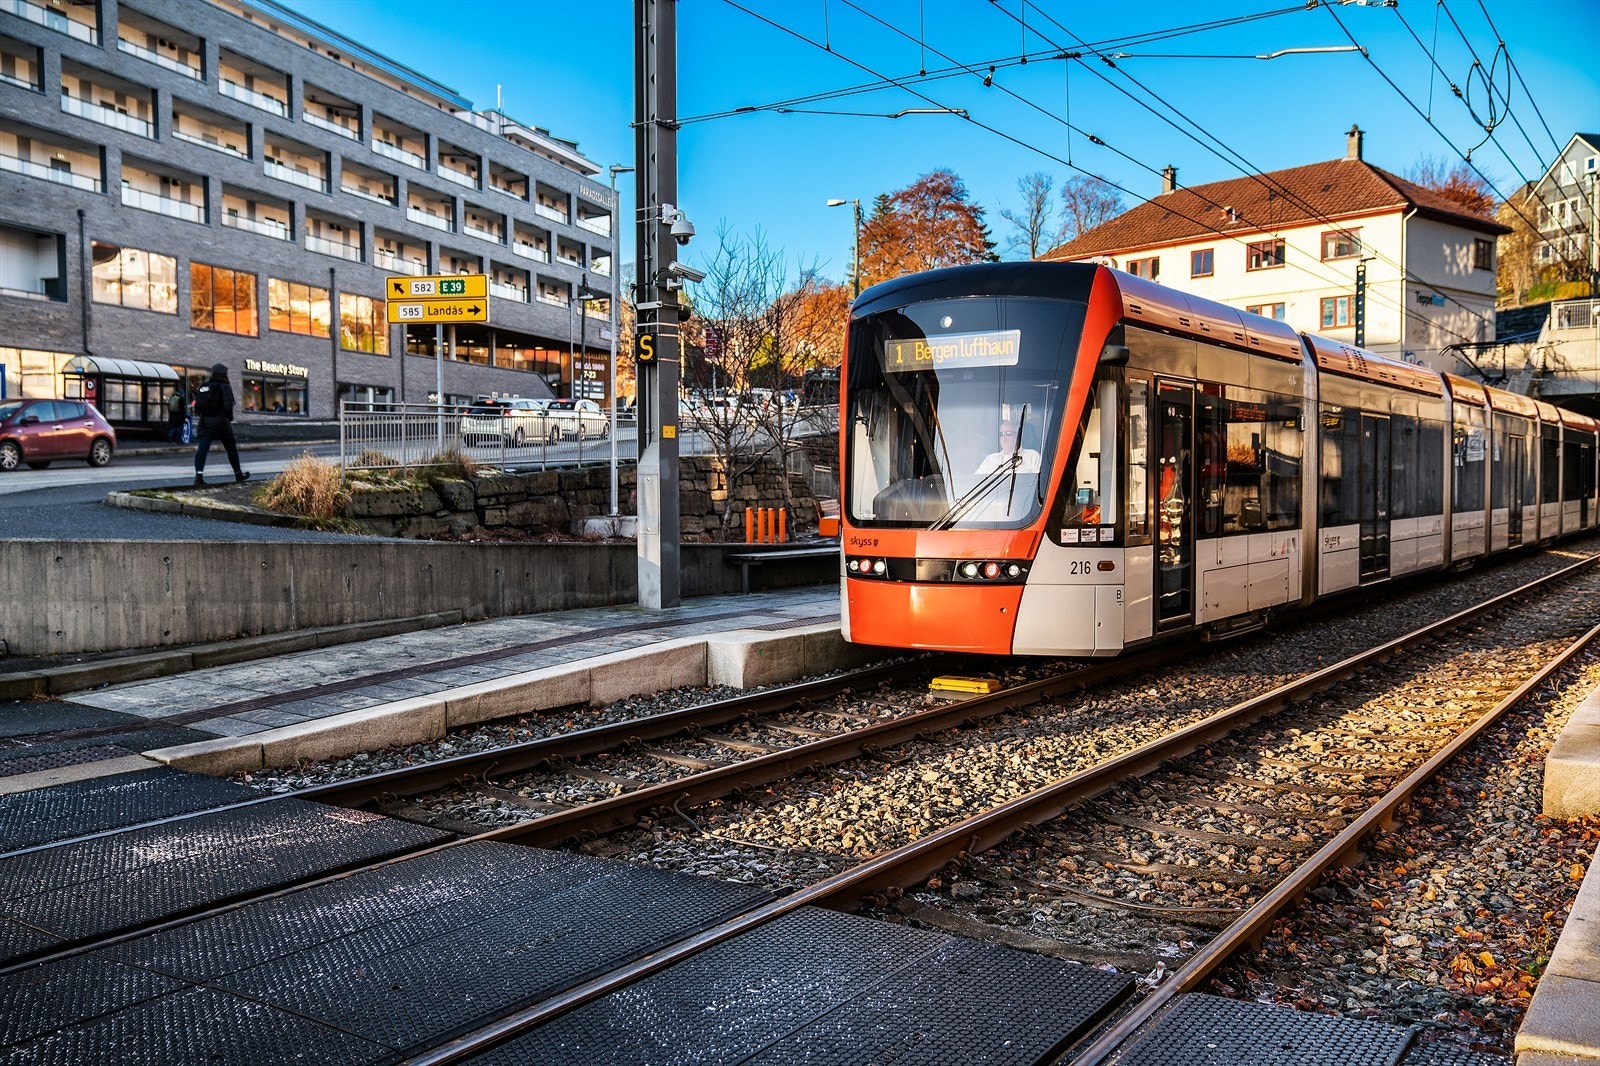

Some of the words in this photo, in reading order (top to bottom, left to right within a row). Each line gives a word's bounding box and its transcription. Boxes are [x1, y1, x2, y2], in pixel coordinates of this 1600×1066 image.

[414, 283, 432, 292] 582
[442, 282, 448, 292] E
[450, 282, 462, 292] 39
[402, 307, 419, 317] 585
[427, 305, 464, 316] Landås
[639, 335, 653, 360] S
[896, 345, 903, 364] 1
[915, 341, 958, 363] Bergen
[245, 358, 260, 371] The
[261, 360, 287, 376] Beauty
[288, 363, 308, 378] Story
[583, 370, 597, 379] 7-23
[850, 536, 872, 548] skyss
[1070, 561, 1091, 575] 216
[1116, 589, 1122, 600] B
